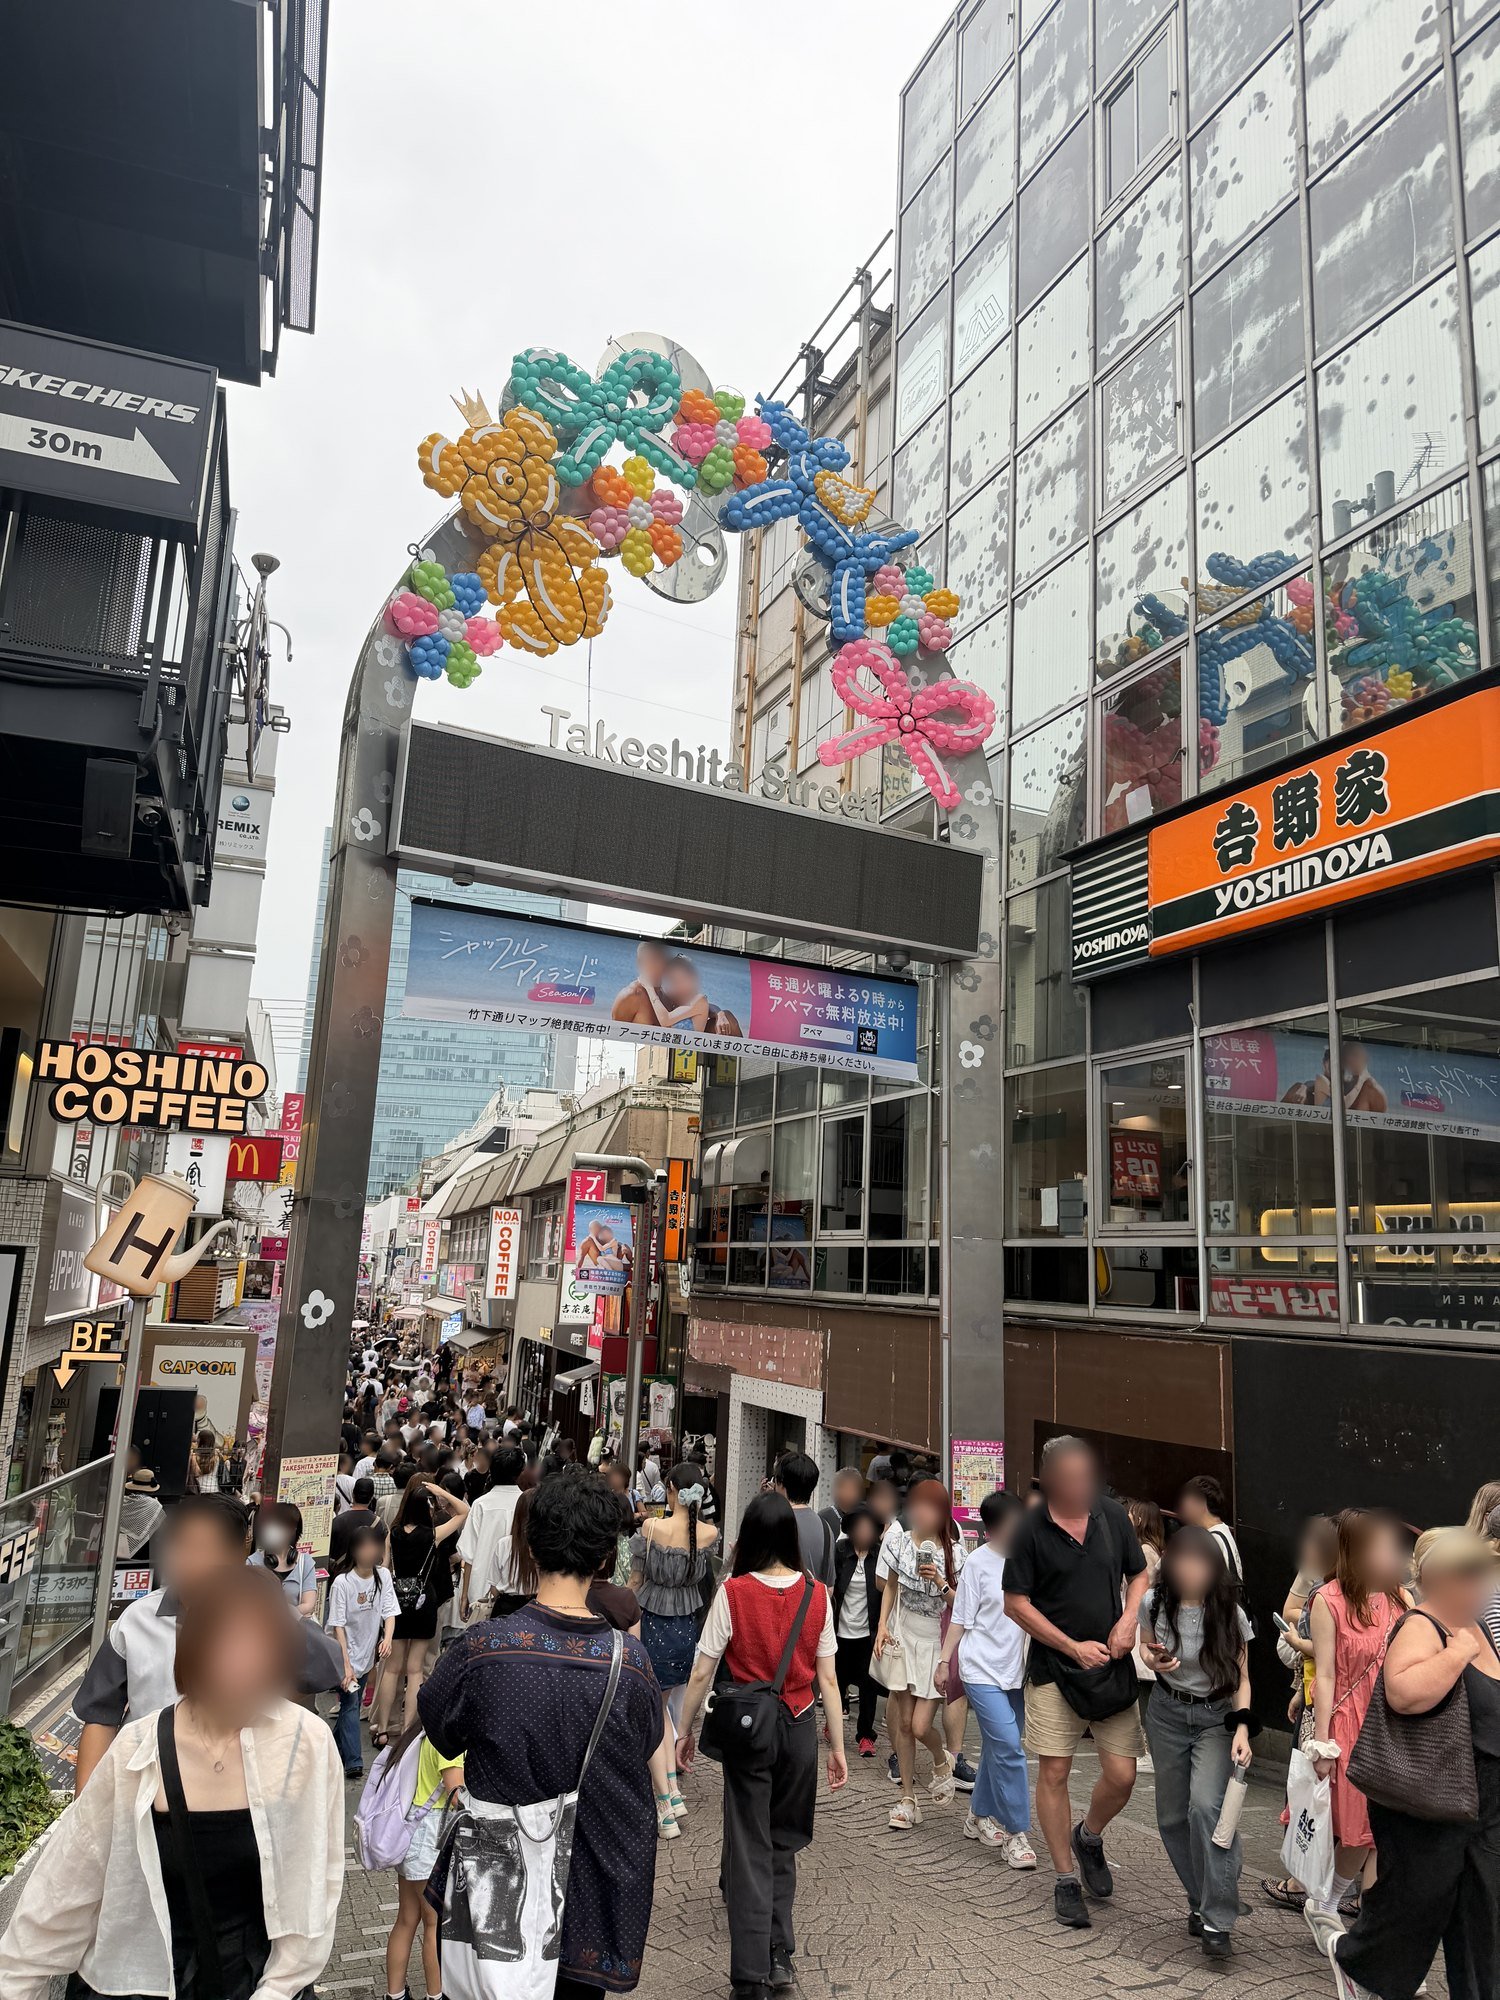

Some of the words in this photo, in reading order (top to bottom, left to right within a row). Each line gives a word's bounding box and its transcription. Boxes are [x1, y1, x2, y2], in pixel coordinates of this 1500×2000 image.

[27, 427, 103, 461] 30m
[540, 703, 745, 793] Takeshita
[761, 761, 878, 823] Street
[217, 819, 261, 834] REMIX
[1212, 748, 1391, 874] 吉野家
[1214, 833, 1392, 916] YOSHINOYA
[439, 930, 548, 972] シャッフル
[1073, 922, 1148, 960] YOSHINOYA
[499, 954, 599, 986] アイランド
[767, 973, 905, 1012] 毎週火曜よる9時から
[619, 1026, 876, 1072] アーチに設置していますのでご自由にお持ち帰りください。
[803, 1027, 823, 1036] アベマ
[39, 1043, 267, 1097] HOSHINO
[55, 1083, 246, 1131] COFFEE
[277, 1189, 295, 1231] 古着
[494, 1210, 520, 1222] NOA
[109, 1211, 175, 1280] H
[424, 1230, 437, 1271] COFFEE
[494, 1226, 513, 1297] COFFEE
[71, 1321, 116, 1352] BF
[159, 1359, 237, 1375] CAPCOM
[282, 1464, 314, 1472] TAKESHITA
[315, 1461, 337, 1469] STREET
[127, 1572, 149, 1583] BF
